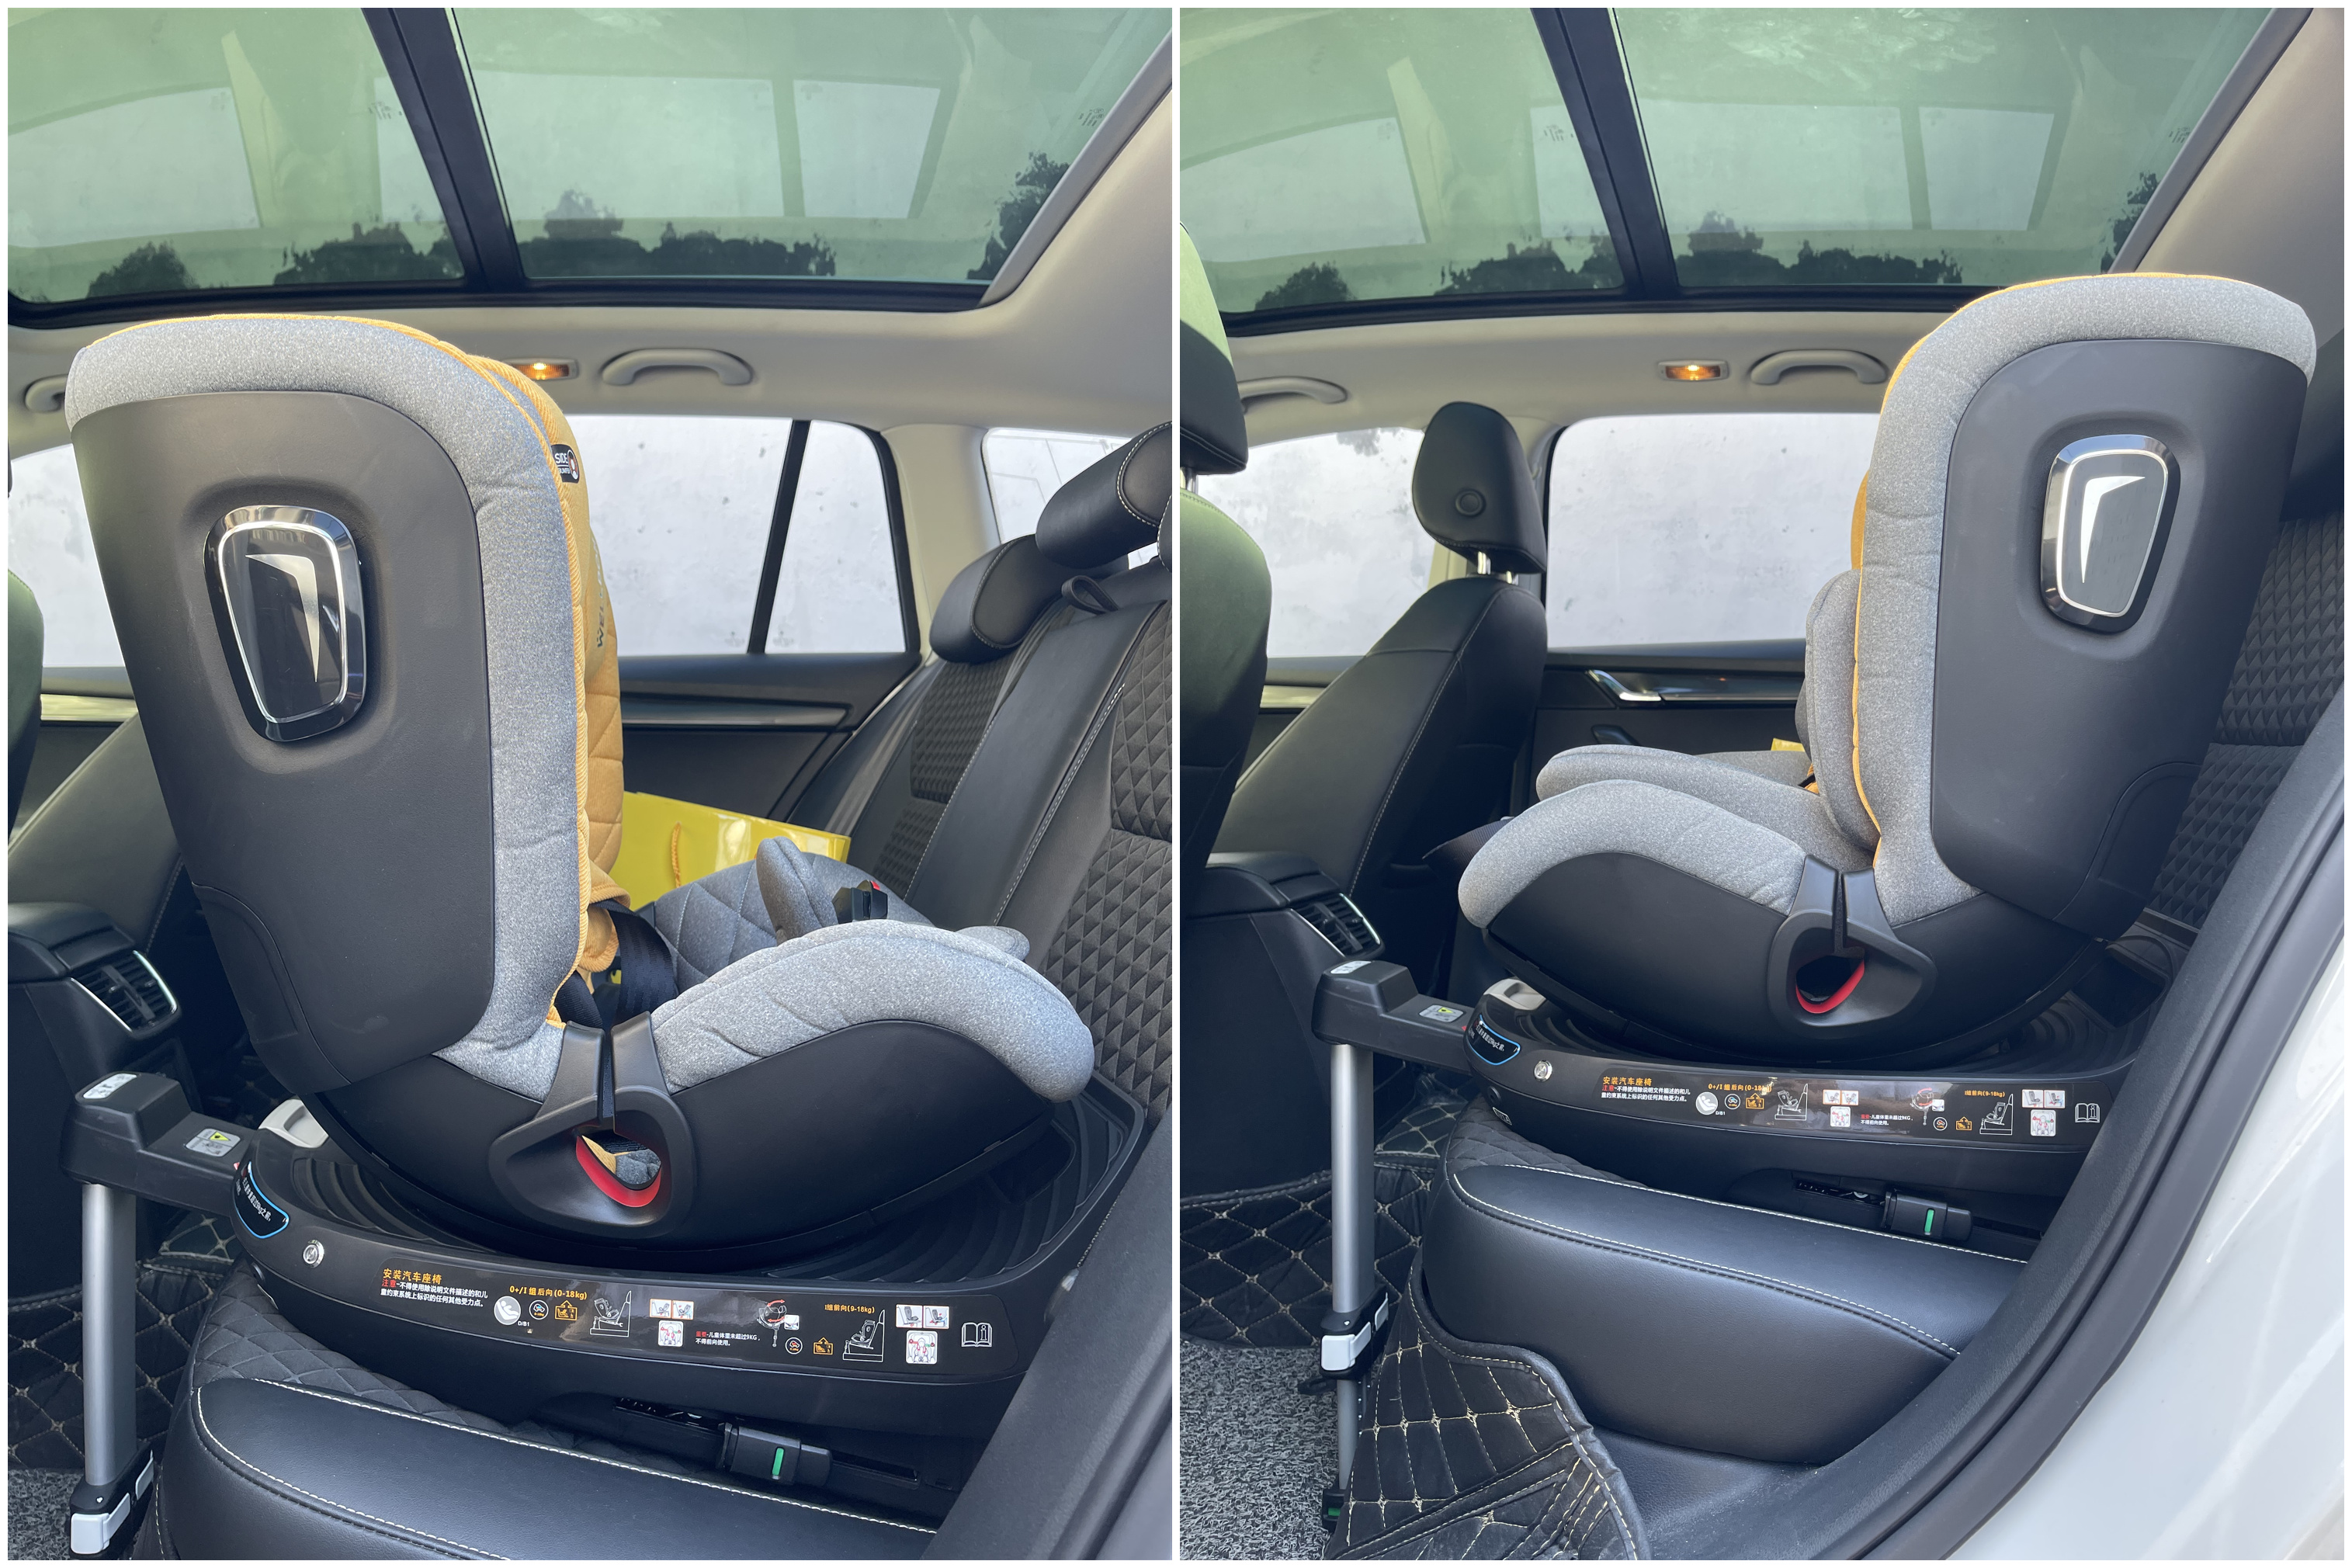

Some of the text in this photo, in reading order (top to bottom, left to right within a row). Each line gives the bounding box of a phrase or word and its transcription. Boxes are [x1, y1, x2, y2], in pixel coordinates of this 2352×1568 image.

[554, 453, 568, 463] SIDE
[1602, 1077, 1653, 1087] 安装汽车座椅
[383, 1268, 442, 1285] 安装汽车座椅
